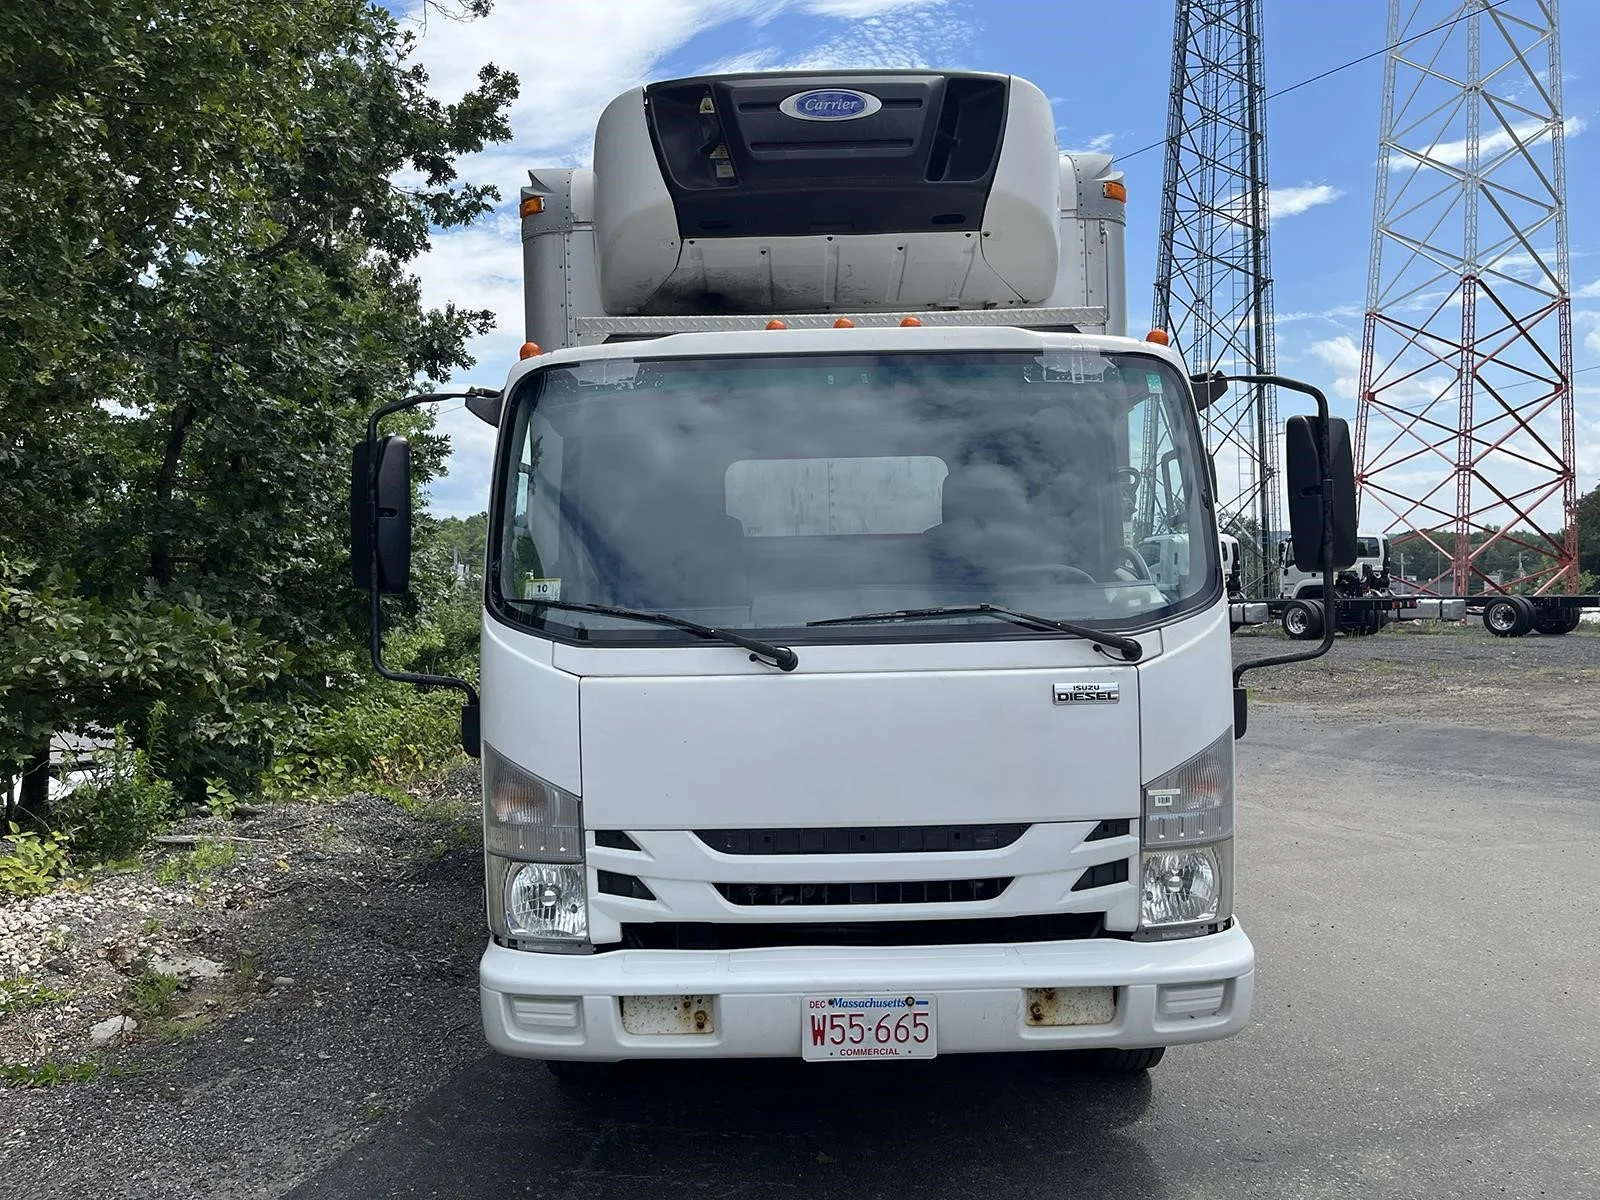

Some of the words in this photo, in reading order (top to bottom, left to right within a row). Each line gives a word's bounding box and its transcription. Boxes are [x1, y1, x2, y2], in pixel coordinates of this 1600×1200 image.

[805, 98, 857, 111] Carrier
[536, 584, 549, 593] 10
[1057, 691, 1118, 702] DIESEL
[809, 1000, 826, 1009] DEC
[832, 997, 906, 1009] Massachusetts
[839, 1048, 900, 1056] COMMERCIAL
